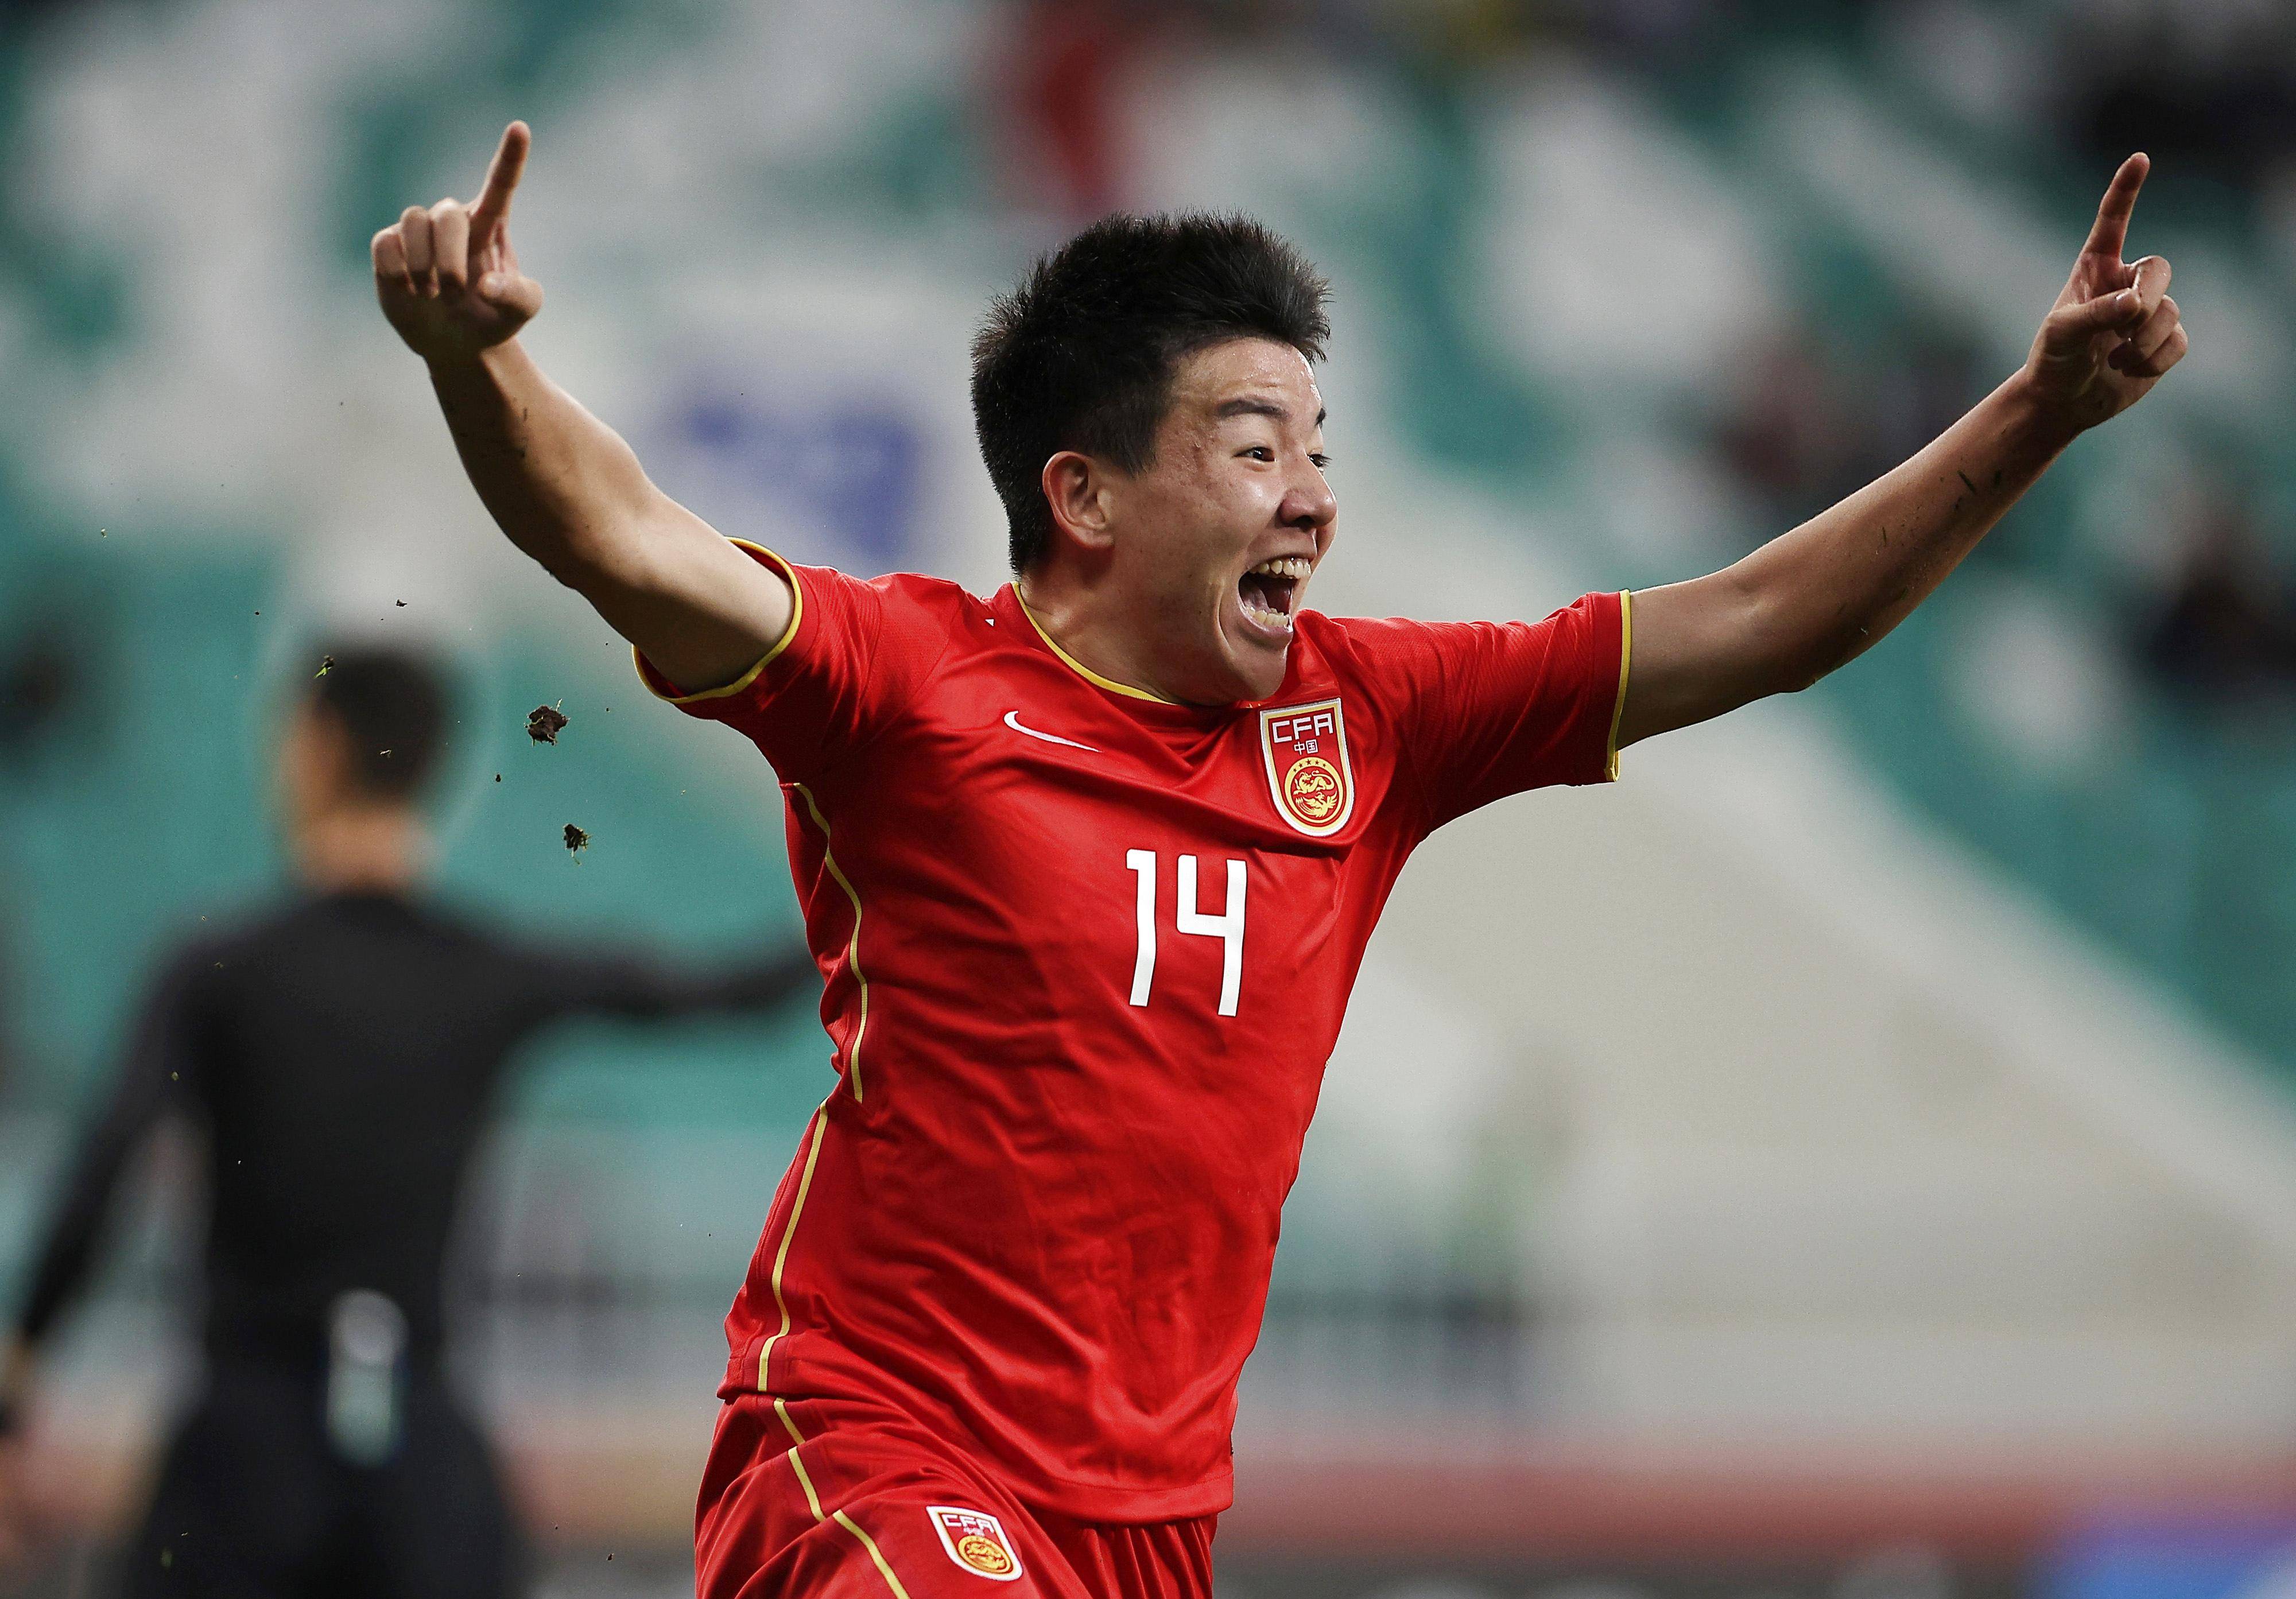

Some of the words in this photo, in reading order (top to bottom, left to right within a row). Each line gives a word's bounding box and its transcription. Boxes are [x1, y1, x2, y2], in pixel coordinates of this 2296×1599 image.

[1272, 713, 1333, 743] CFA
[1294, 739, 1318, 755] 中国
[1126, 849, 1247, 1016] 14
[942, 1514, 995, 1534] CFA
